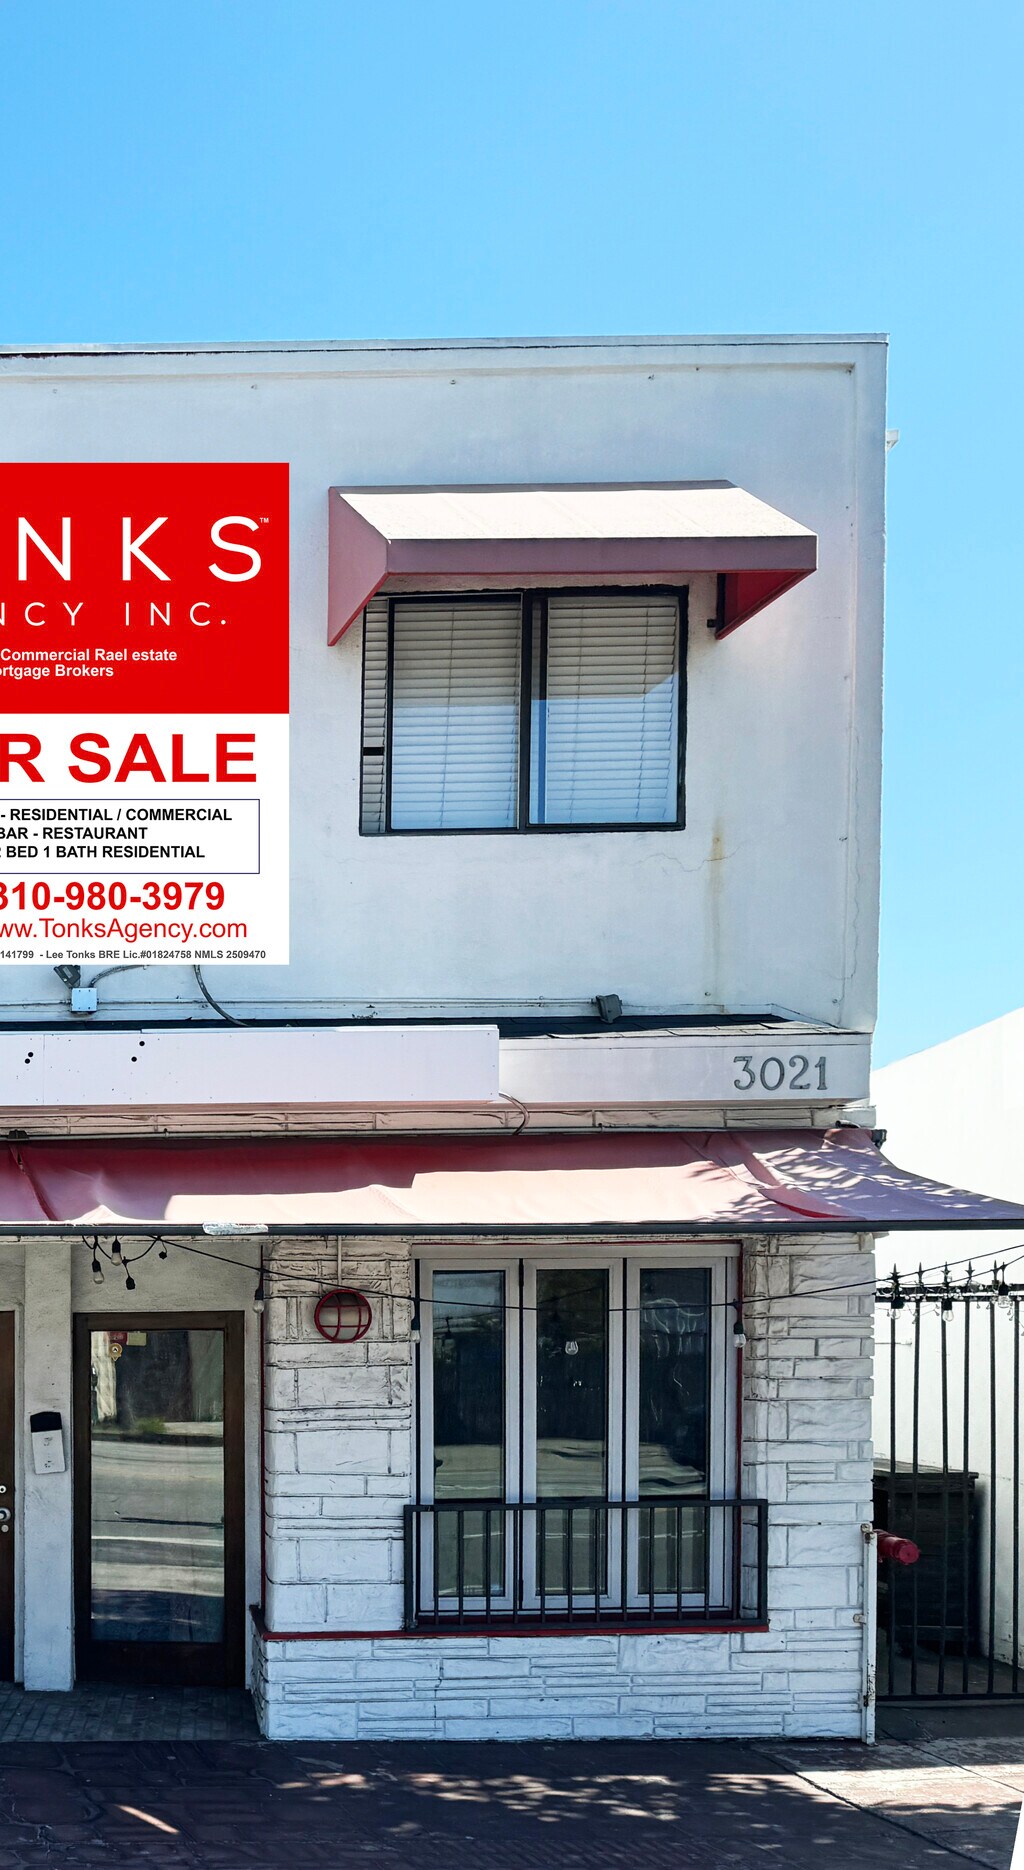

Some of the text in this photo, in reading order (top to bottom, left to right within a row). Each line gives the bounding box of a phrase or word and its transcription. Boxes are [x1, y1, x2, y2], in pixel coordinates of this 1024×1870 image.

[125, 602, 226, 626] INC.
[0, 648, 90, 661] Commercial
[94, 648, 128, 661] Rael
[131, 648, 178, 661] estate
[55, 663, 114, 677] Brokers
[68, 732, 257, 784] SALE
[10, 808, 114, 821] RESIDENTIAL
[116, 808, 122, 821] /
[125, 808, 233, 821] COMMERCIAL
[42, 826, 149, 840] RESTAURANT
[6, 845, 39, 858] BED
[43, 845, 50, 858] 1
[56, 845, 97, 858] BATH
[102, 845, 206, 859] RESIDENTIAL
[46, 950, 64, 959] Lee
[66, 950, 96, 959] Tonks
[98, 950, 121, 959] BRE
[122, 950, 192, 959] Lic.#01824758
[194, 950, 224, 959] NMLS
[226, 950, 267, 959] 2509470
[733, 1054, 828, 1091] 3021
